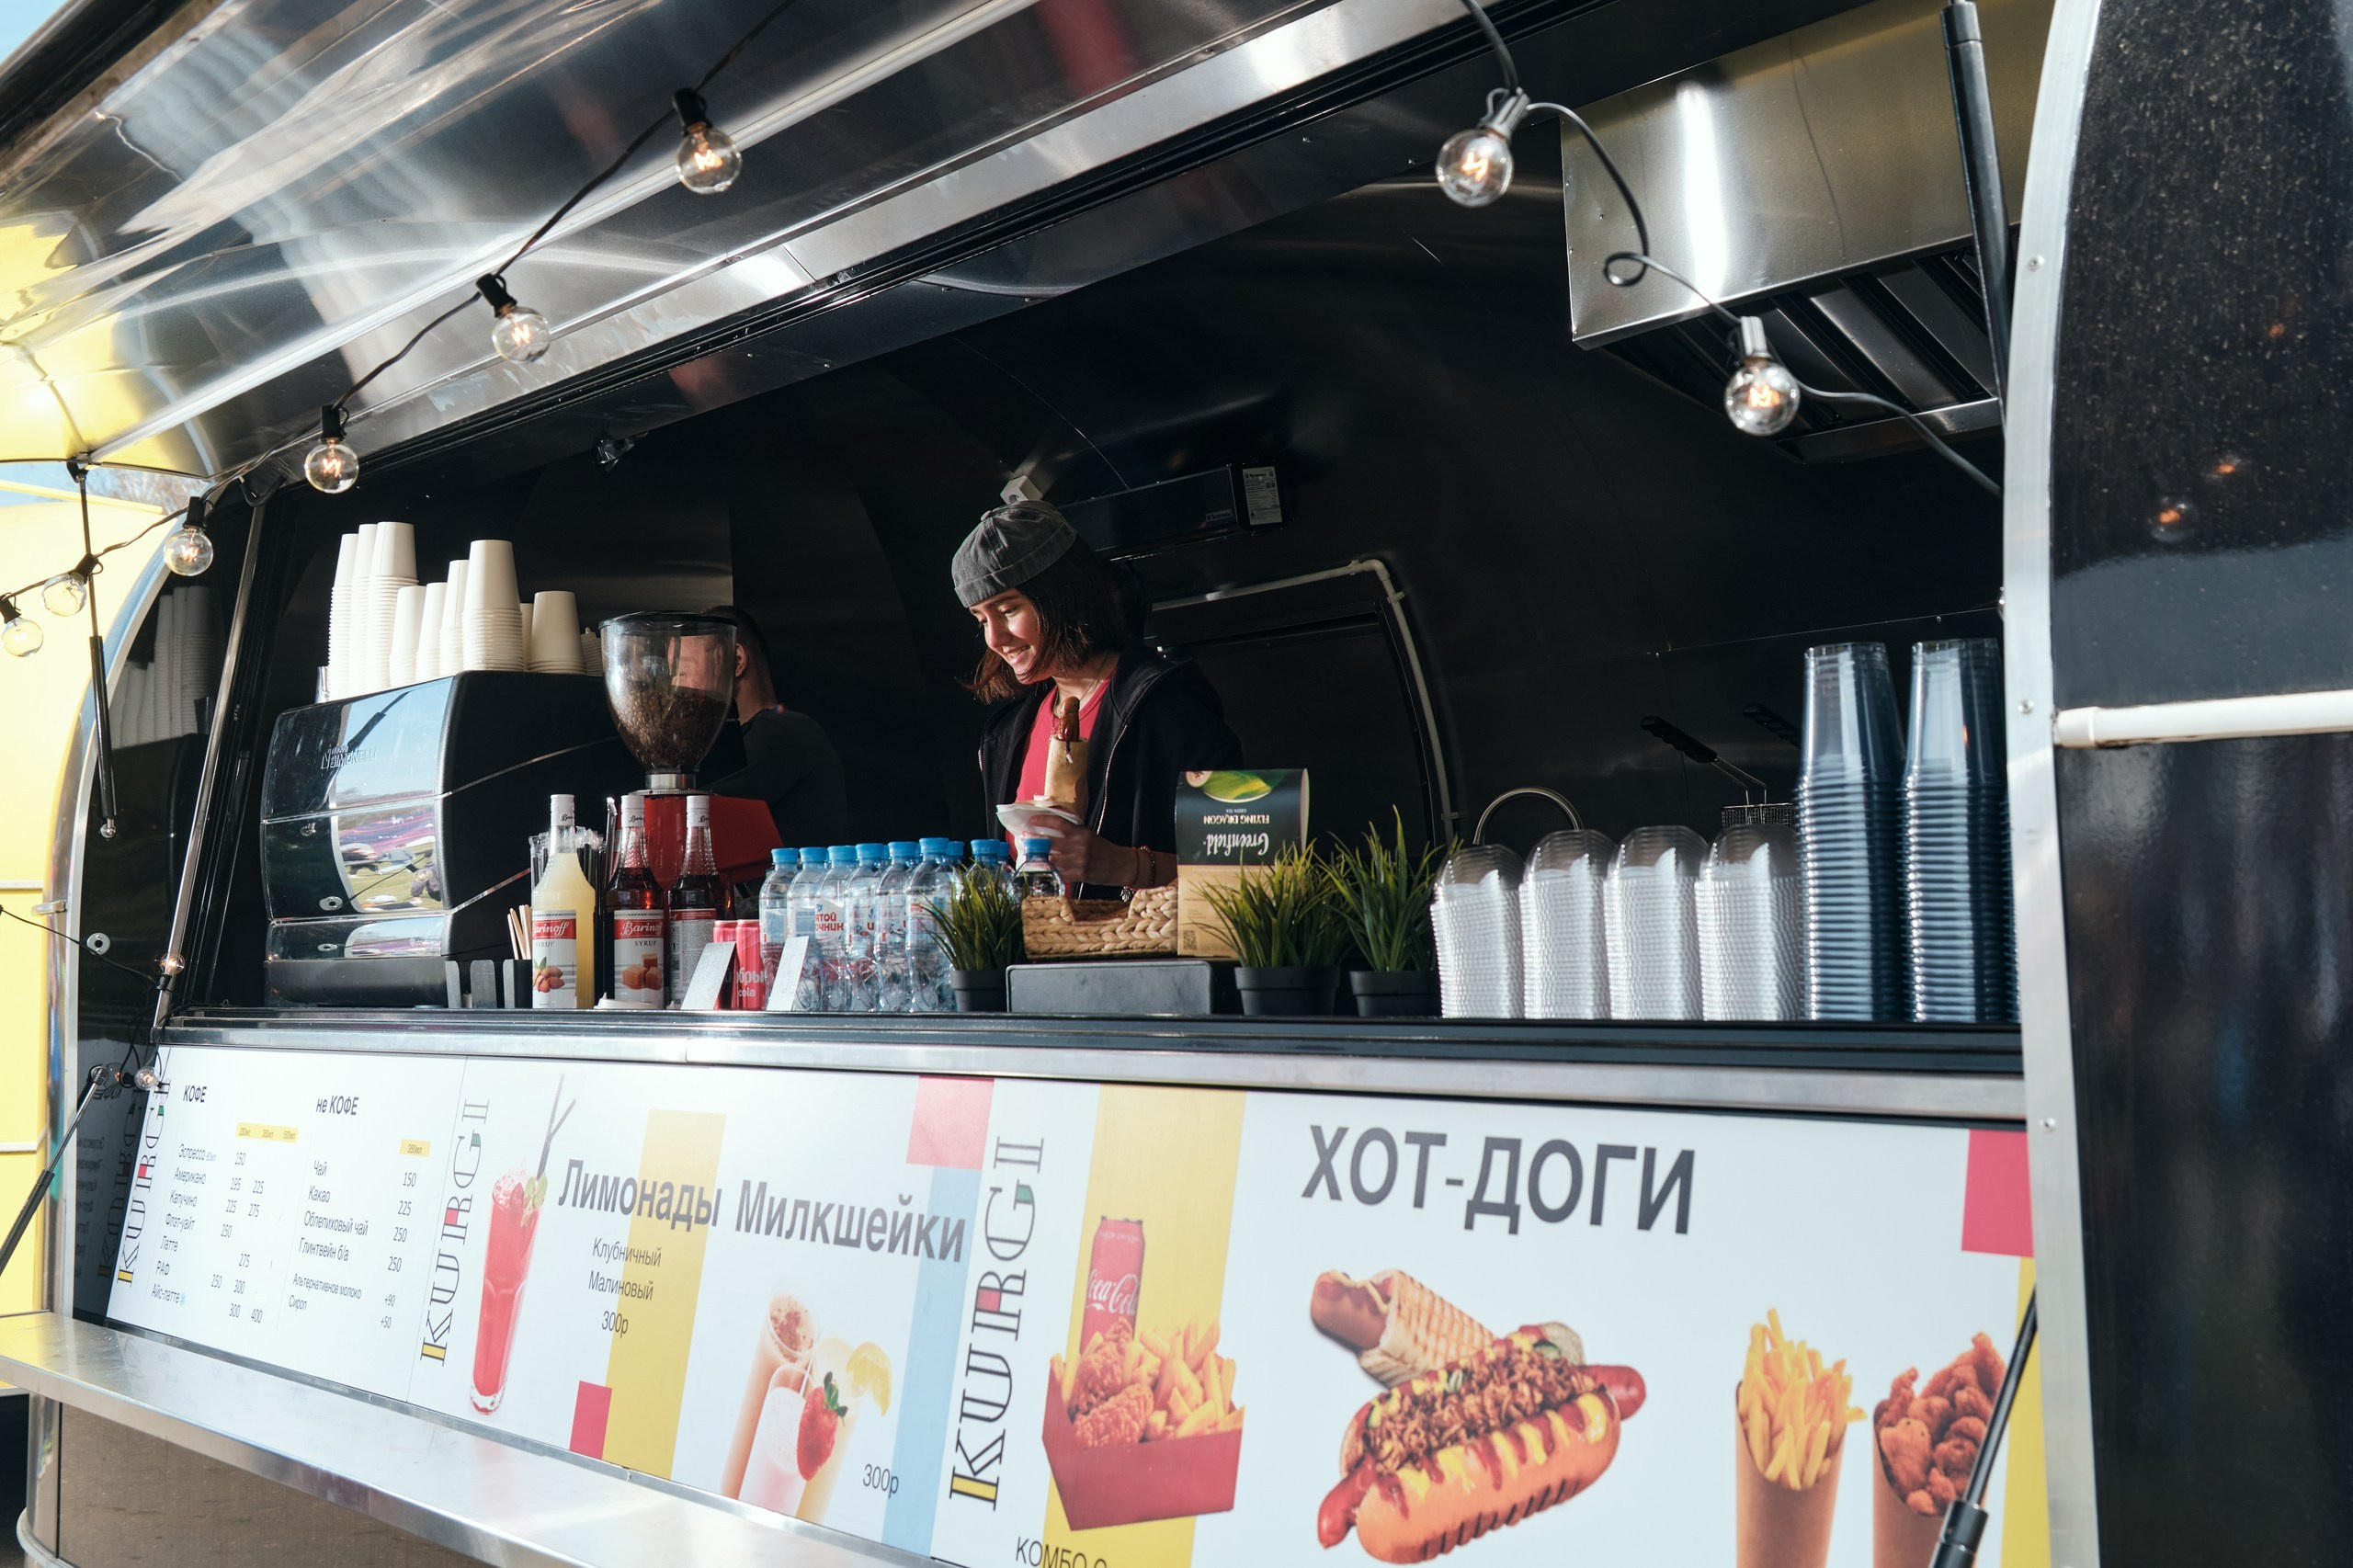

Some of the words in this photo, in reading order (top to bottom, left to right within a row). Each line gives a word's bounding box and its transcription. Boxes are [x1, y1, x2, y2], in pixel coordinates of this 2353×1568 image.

[1203, 814, 1239, 824] DRAGON
[1240, 814, 1270, 824] FLYING
[1206, 833, 1269, 857] Greenfield
[738, 987, 756, 997] cola
[183, 1085, 207, 1103] КОФЕ
[316, 1098, 328, 1113] не
[329, 1095, 359, 1115] КОФЕ
[178, 1143, 206, 1162] Эспрессо
[234, 1152, 246, 1165] 150
[174, 1166, 207, 1186] Американо
[230, 1177, 242, 1191] 195
[252, 1180, 265, 1194] 225
[313, 1159, 328, 1176] Чай
[403, 1171, 417, 1187] 150
[1301, 1124, 1697, 1236] ХОТ-ДОГИ
[169, 1188, 198, 1208] Капучино
[225, 1199, 237, 1214] 225
[248, 1203, 260, 1218] 275
[308, 1185, 331, 1203] Какао
[397, 1200, 412, 1216] 225
[558, 1159, 722, 1233] Лимонады
[735, 1179, 966, 1263] Милкшейки
[165, 1213, 195, 1233] Флэт-уайт
[221, 1223, 233, 1238] 250
[304, 1210, 354, 1233] Облепиховый
[355, 1220, 369, 1235] чай
[393, 1227, 407, 1243] 250
[420, 1099, 490, 1367] KURGI
[160, 1235, 178, 1252] Латте
[239, 1253, 251, 1268] 275
[299, 1237, 336, 1259] Глинтвейн
[337, 1244, 349, 1261] б/а
[388, 1256, 402, 1272] 250
[592, 1236, 662, 1267] Клубничный
[155, 1260, 170, 1276] РАФ
[210, 1274, 222, 1289] 250
[233, 1279, 245, 1294] 300
[292, 1273, 339, 1295] Альтернативное
[339, 1285, 362, 1300] молоко
[384, 1294, 396, 1307] +90
[588, 1270, 654, 1301] Малиновый
[151, 1283, 180, 1303] Айс-латте
[229, 1302, 241, 1318] 300
[251, 1309, 263, 1324] 400
[289, 1294, 307, 1312] Сироп
[381, 1315, 392, 1329] +50
[601, 1310, 629, 1338] 300р
[949, 1136, 1044, 1512] KURGI
[862, 1464, 900, 1499] 300р
[1016, 1537, 1087, 1568] КОМБО
